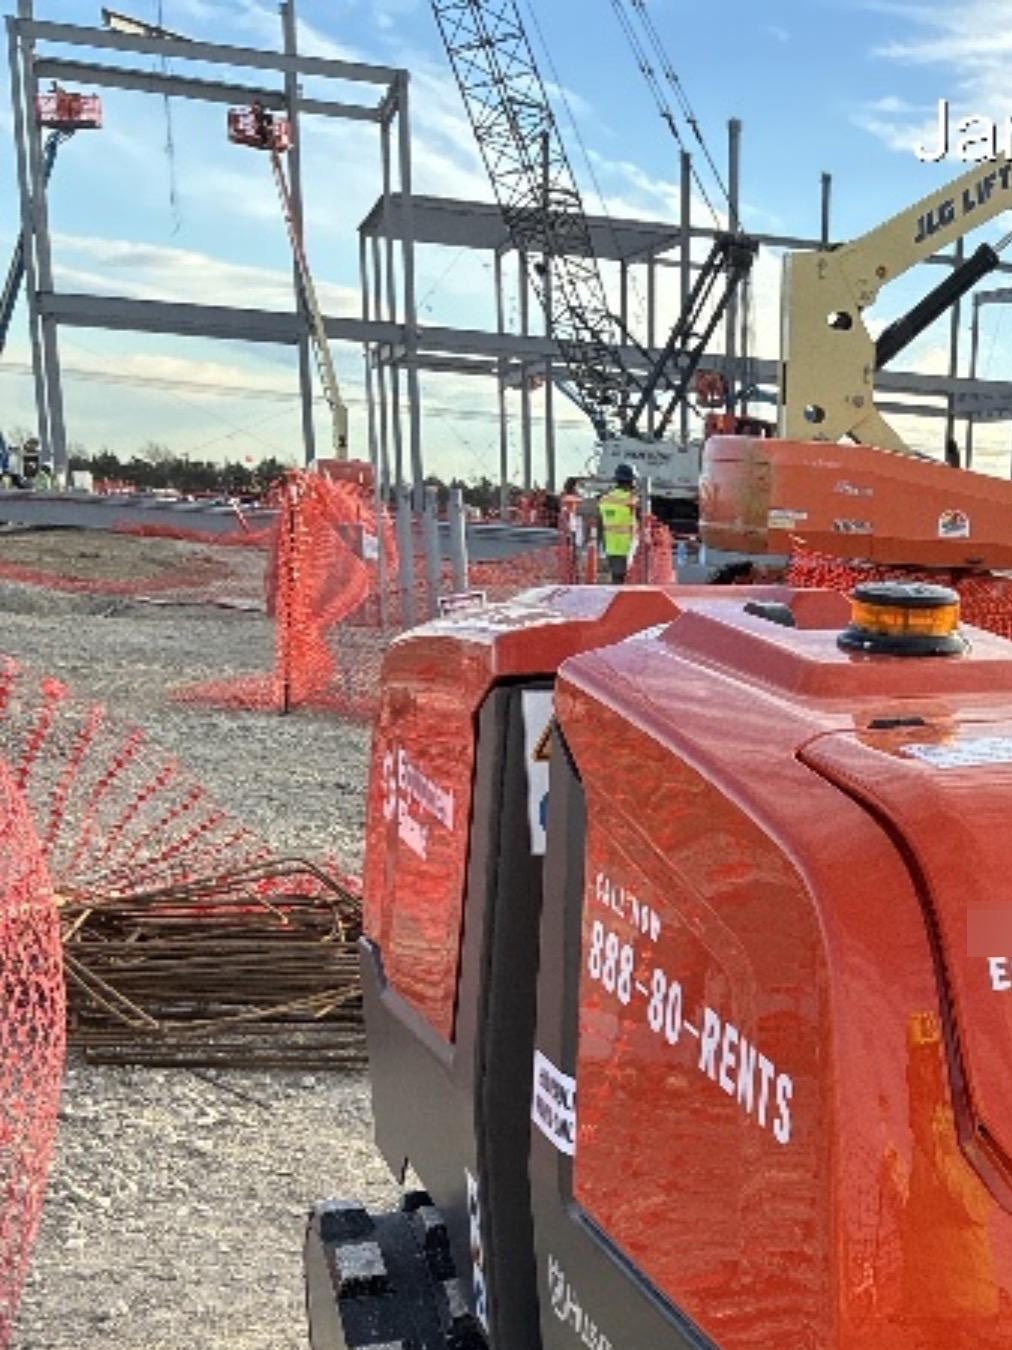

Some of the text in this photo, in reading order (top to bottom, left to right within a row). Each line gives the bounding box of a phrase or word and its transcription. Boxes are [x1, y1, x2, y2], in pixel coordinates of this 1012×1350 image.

[914, 164, 1012, 243] JLG LIFT
[588, 920, 794, 1145] 888-80-RENTS
